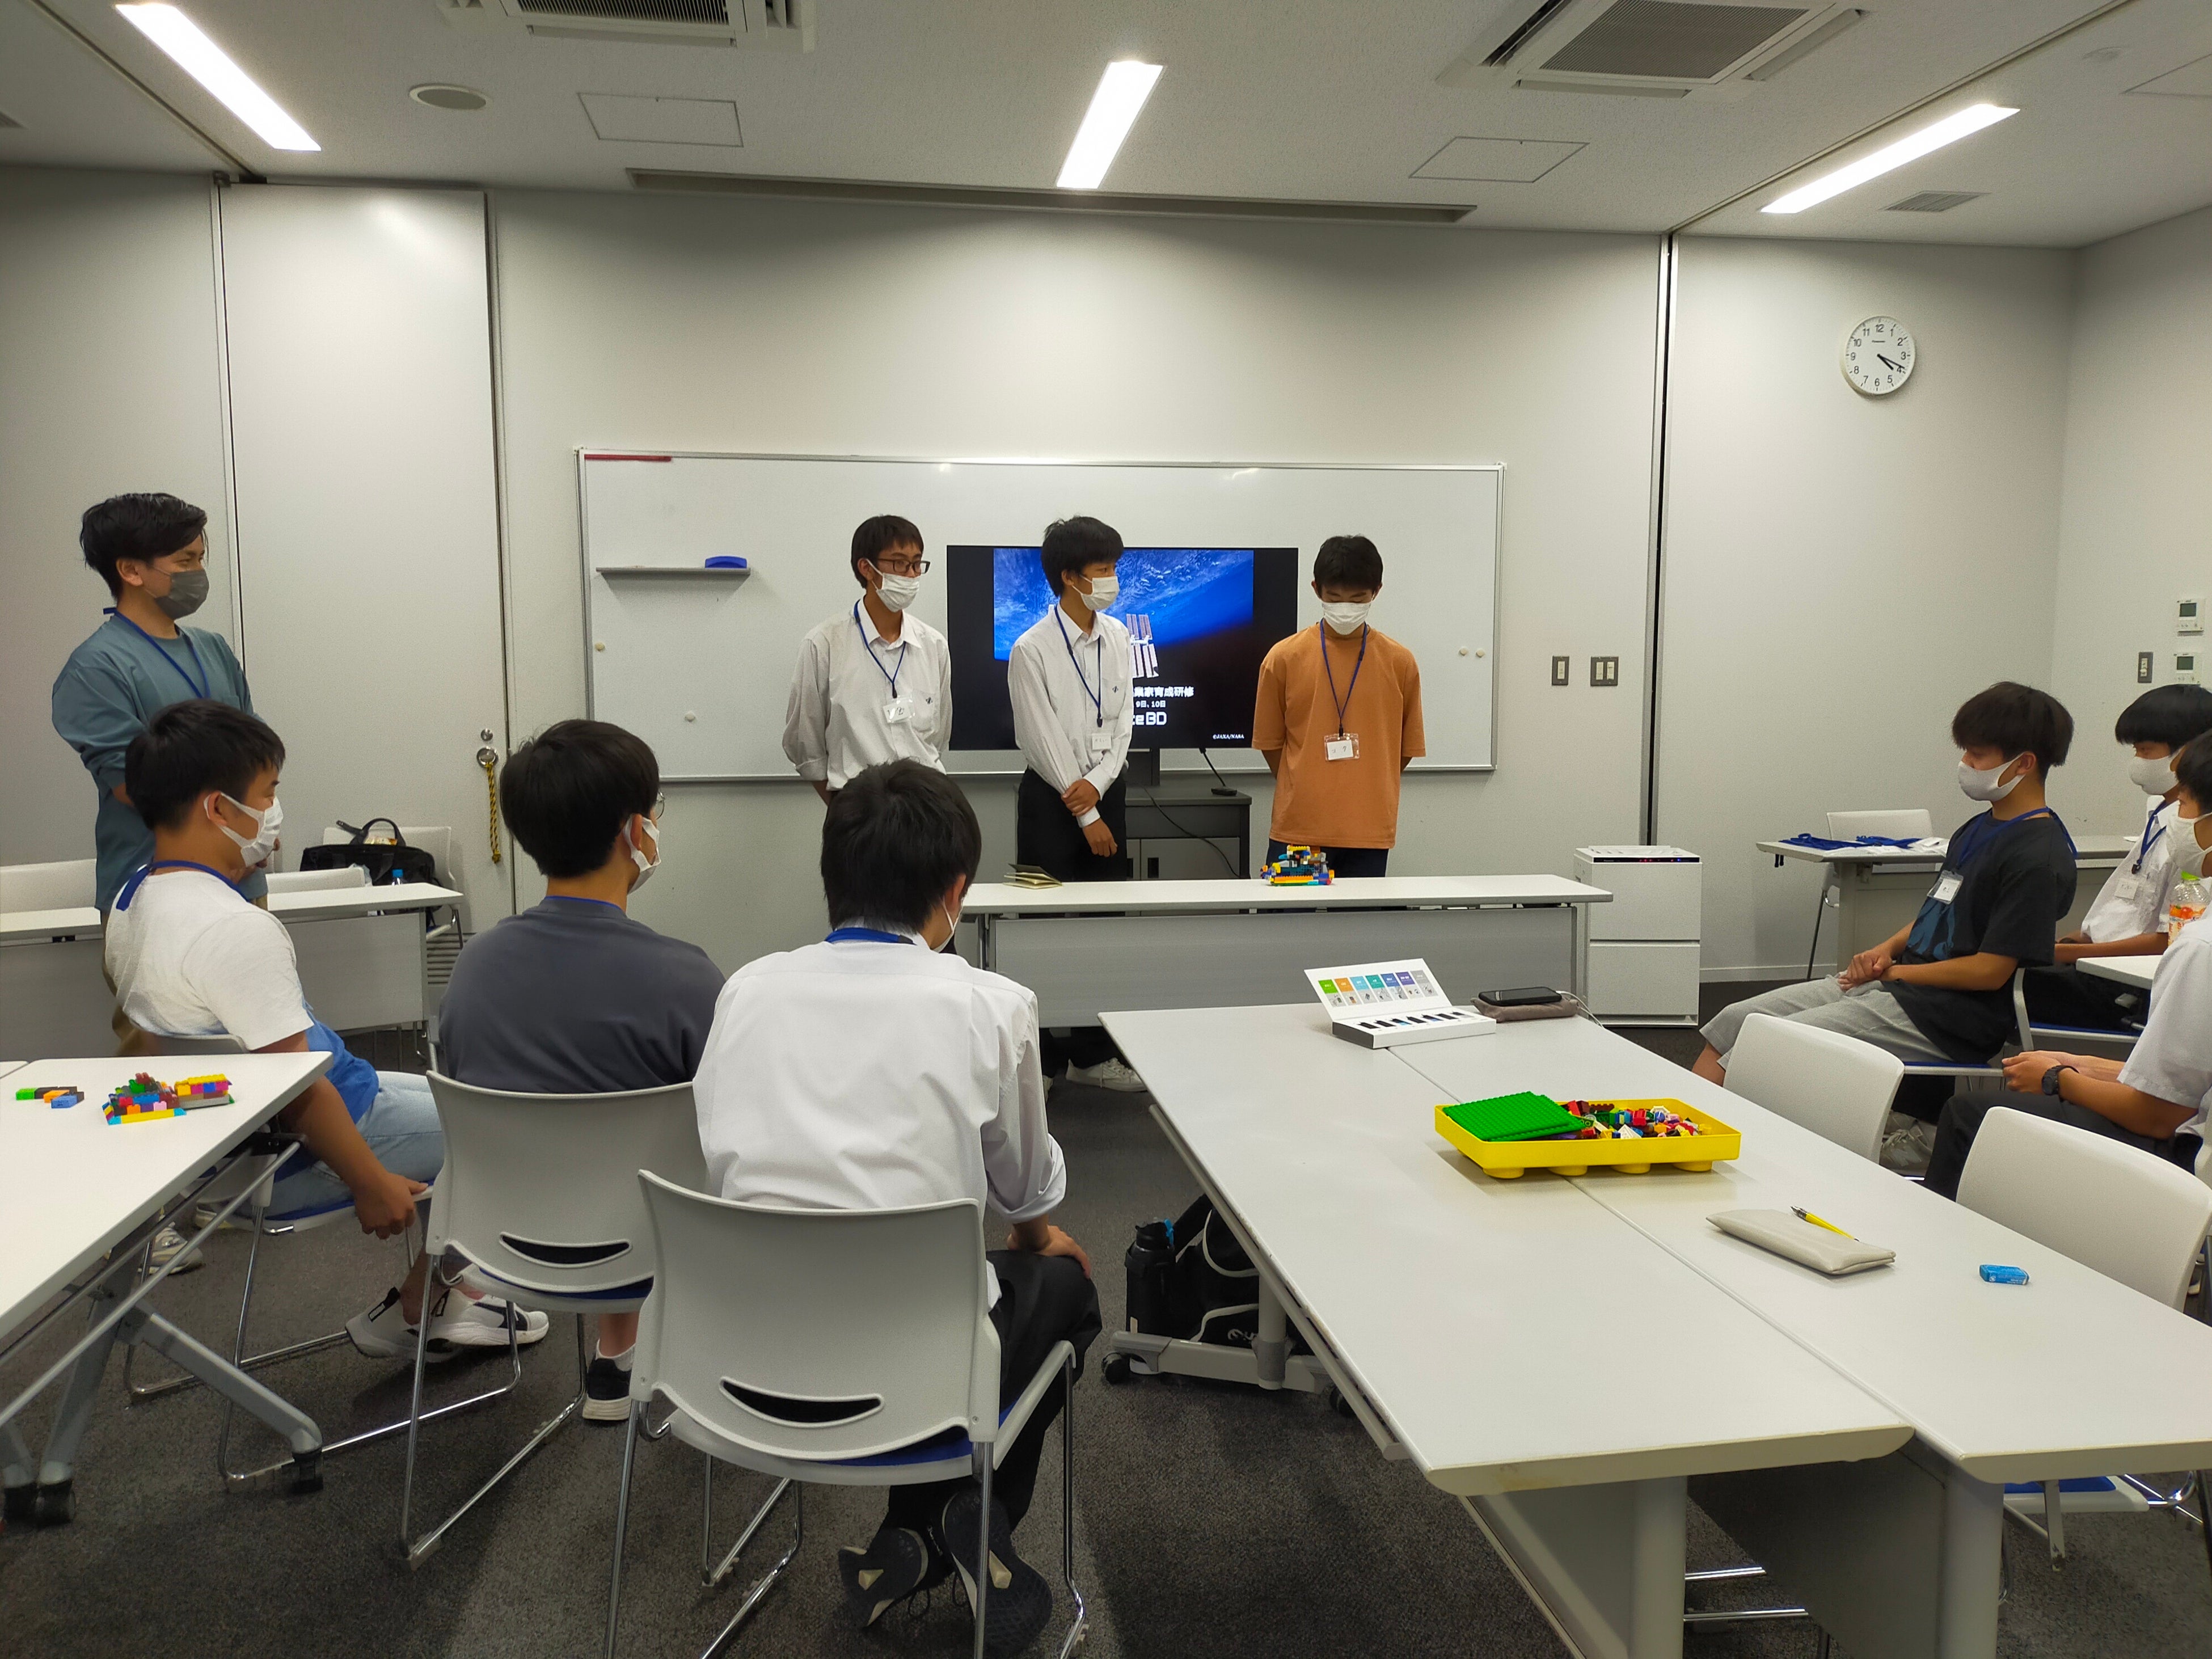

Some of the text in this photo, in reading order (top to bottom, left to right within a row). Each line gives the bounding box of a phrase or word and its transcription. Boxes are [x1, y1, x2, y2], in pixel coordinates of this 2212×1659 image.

[1876, 324, 1884, 332] 12
[1863, 375, 1868, 384] 7
[1888, 375, 1893, 383] 5
[1133, 686, 1194, 698] 業家育成研修
